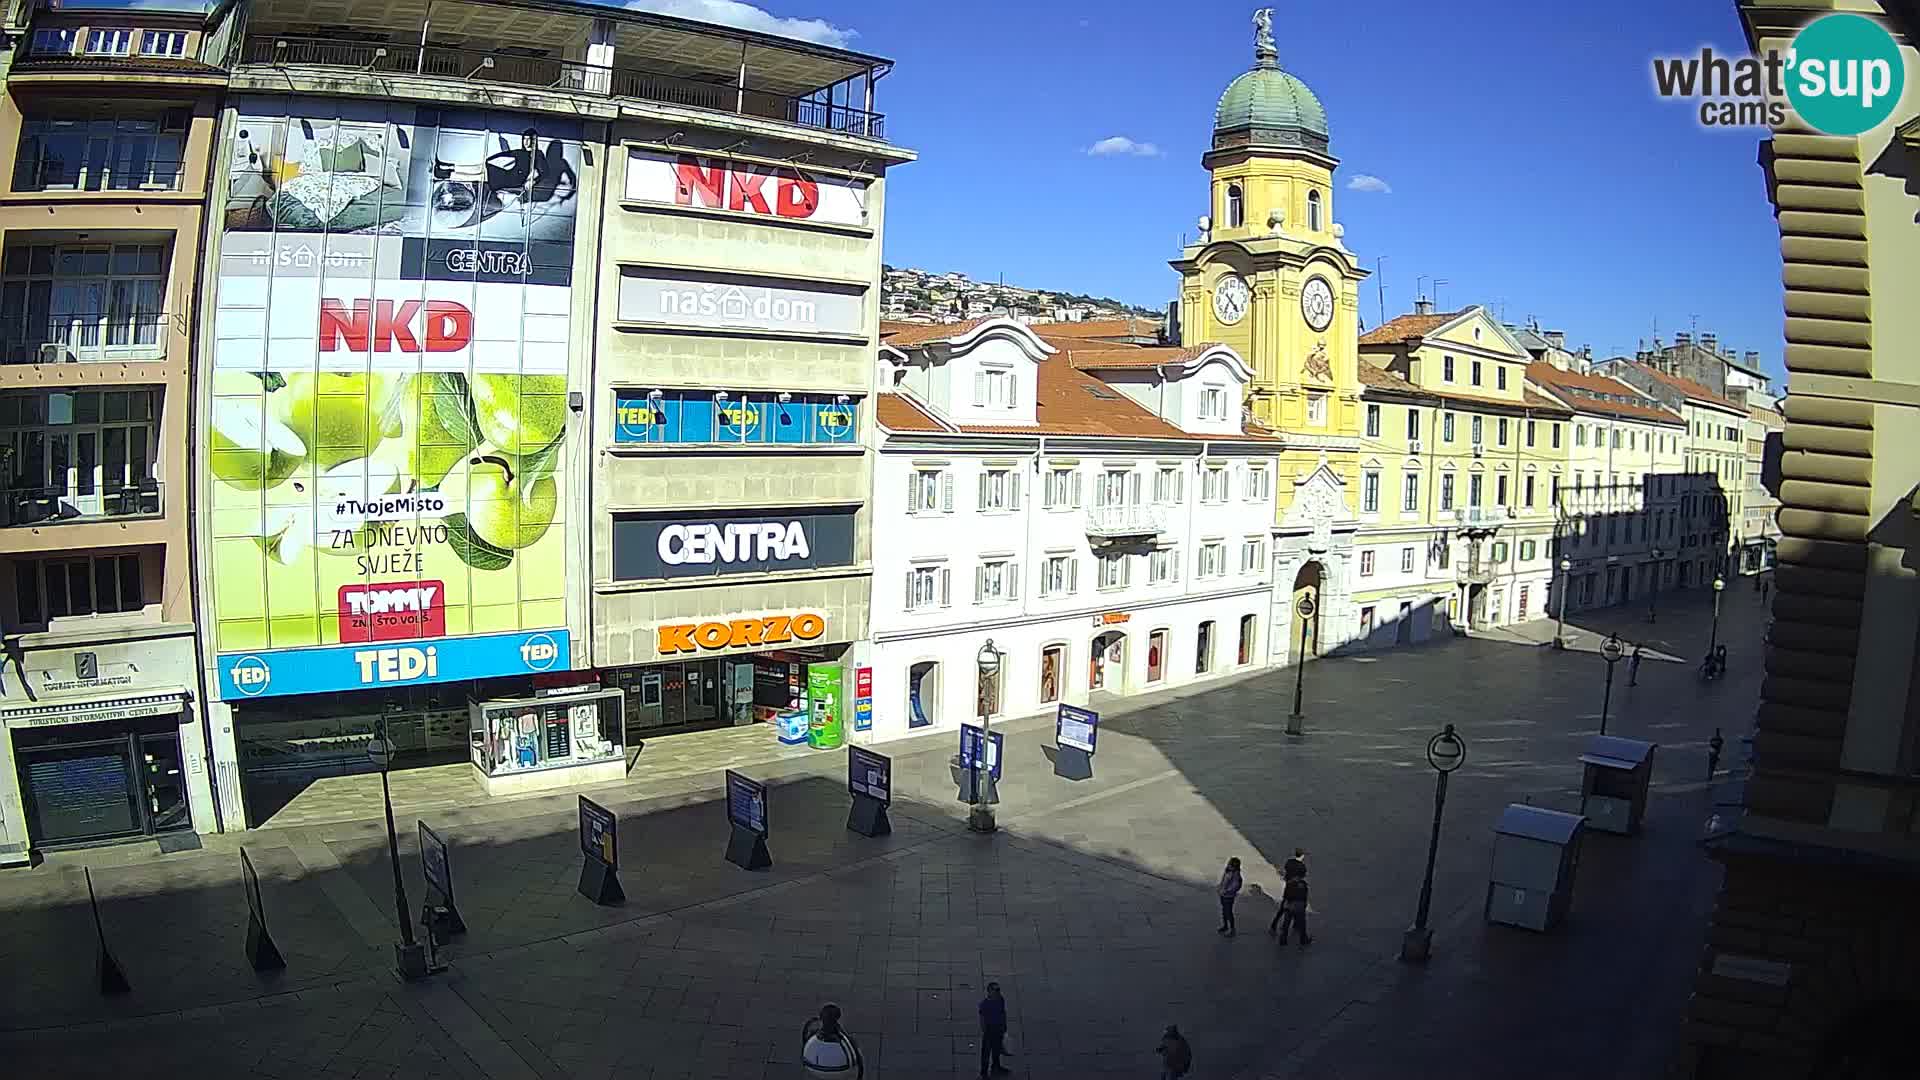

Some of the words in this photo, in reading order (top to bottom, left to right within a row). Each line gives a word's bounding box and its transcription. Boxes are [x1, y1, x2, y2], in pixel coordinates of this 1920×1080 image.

[674, 152, 820, 219] NKD
[446, 249, 534, 275] CENTRA
[659, 284, 717, 316] naš
[753, 287, 817, 323] dom
[319, 297, 473, 354] NKD
[617, 408, 657, 425] TEDi
[819, 411, 853, 427] TEi
[336, 497, 444, 517] #TvojeMisto
[331, 529, 355, 550] ZA
[367, 524, 448, 548] DNEVNO
[657, 520, 810, 565] CENTRA
[357, 548, 424, 576] SVJEŽE
[346, 586, 438, 616] TOMMY
[376, 614, 398, 626] ŠTO
[400, 611, 433, 625] VOLŠ.
[657, 613, 823, 654] KORZO
[354, 646, 439, 684] TEDi
[519, 643, 559, 663] TEDi
[230, 666, 271, 685] TEDi
[128, 706, 159, 717] CENTAR
